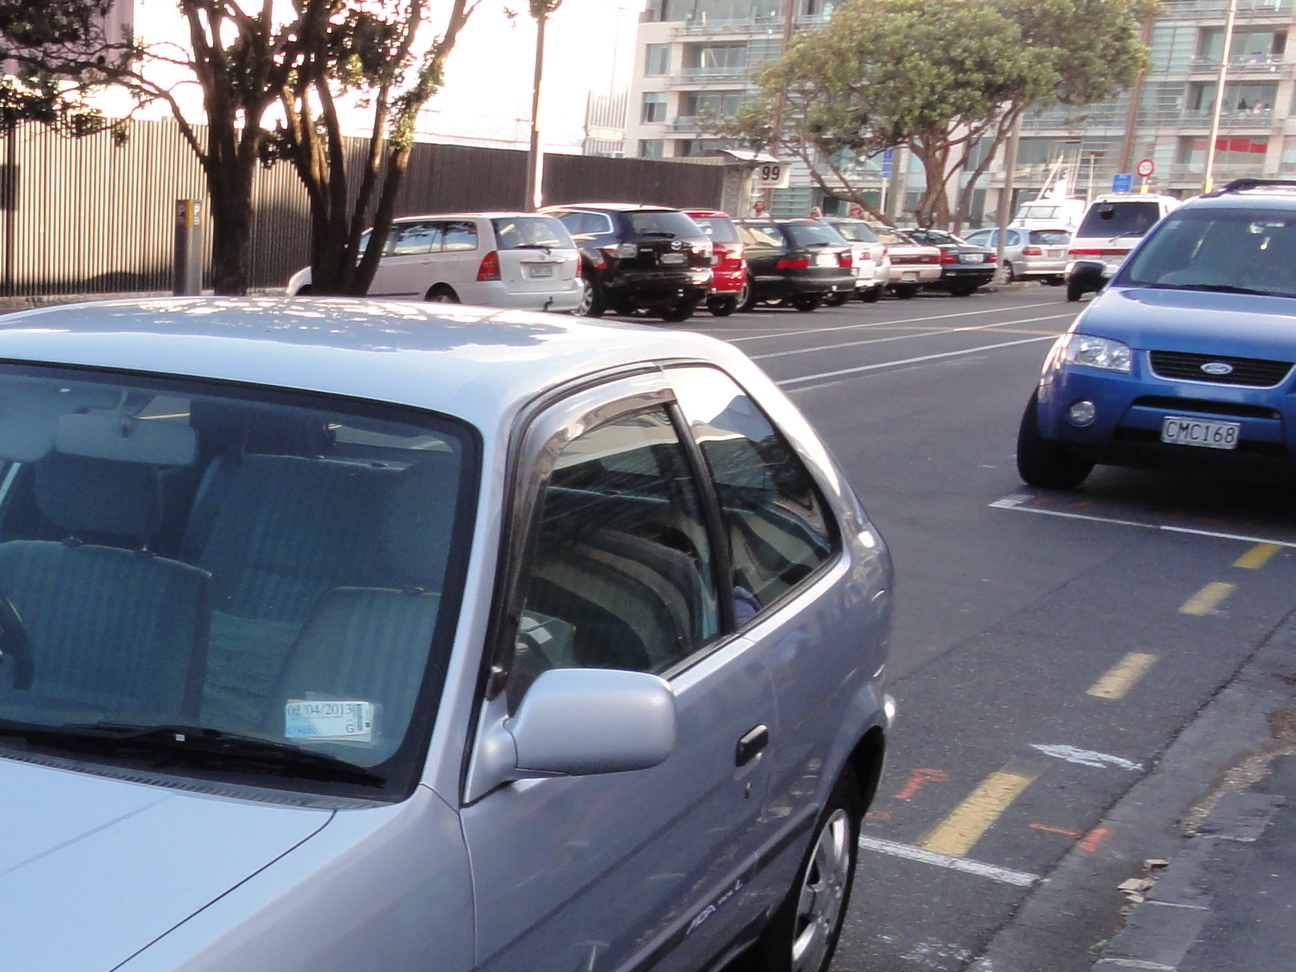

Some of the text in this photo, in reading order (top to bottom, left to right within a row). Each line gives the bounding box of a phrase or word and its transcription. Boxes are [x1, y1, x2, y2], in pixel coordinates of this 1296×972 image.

[761, 166, 780, 181] 99
[1165, 421, 1235, 443] CMC168
[345, 724, 355, 734] G
